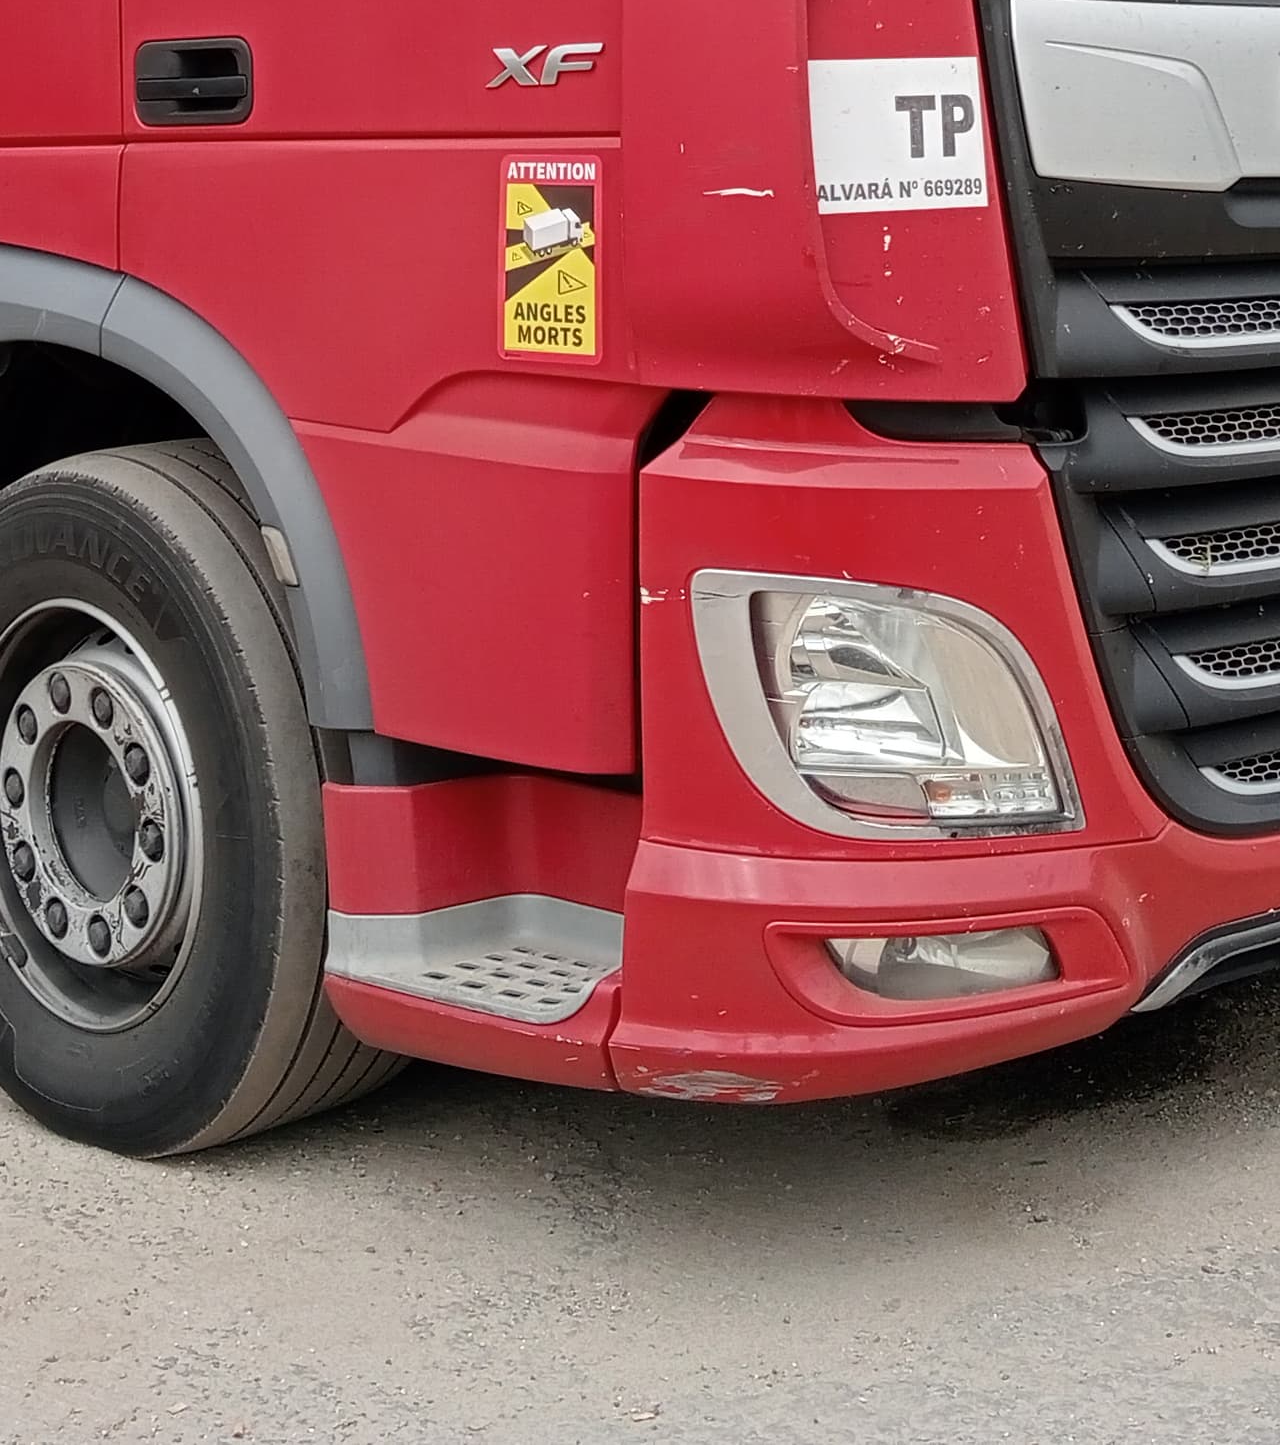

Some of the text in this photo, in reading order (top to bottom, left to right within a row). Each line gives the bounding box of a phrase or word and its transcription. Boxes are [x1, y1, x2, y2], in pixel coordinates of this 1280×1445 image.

[486, 42, 604, 89] XF
[894, 94, 977, 159] TP
[508, 162, 597, 182] ATTENTION
[817, 180, 894, 204] ALVARÁ
[922, 177, 984, 199] 669289
[513, 302, 588, 325] ANGLES
[517, 326, 584, 348] MORTS
